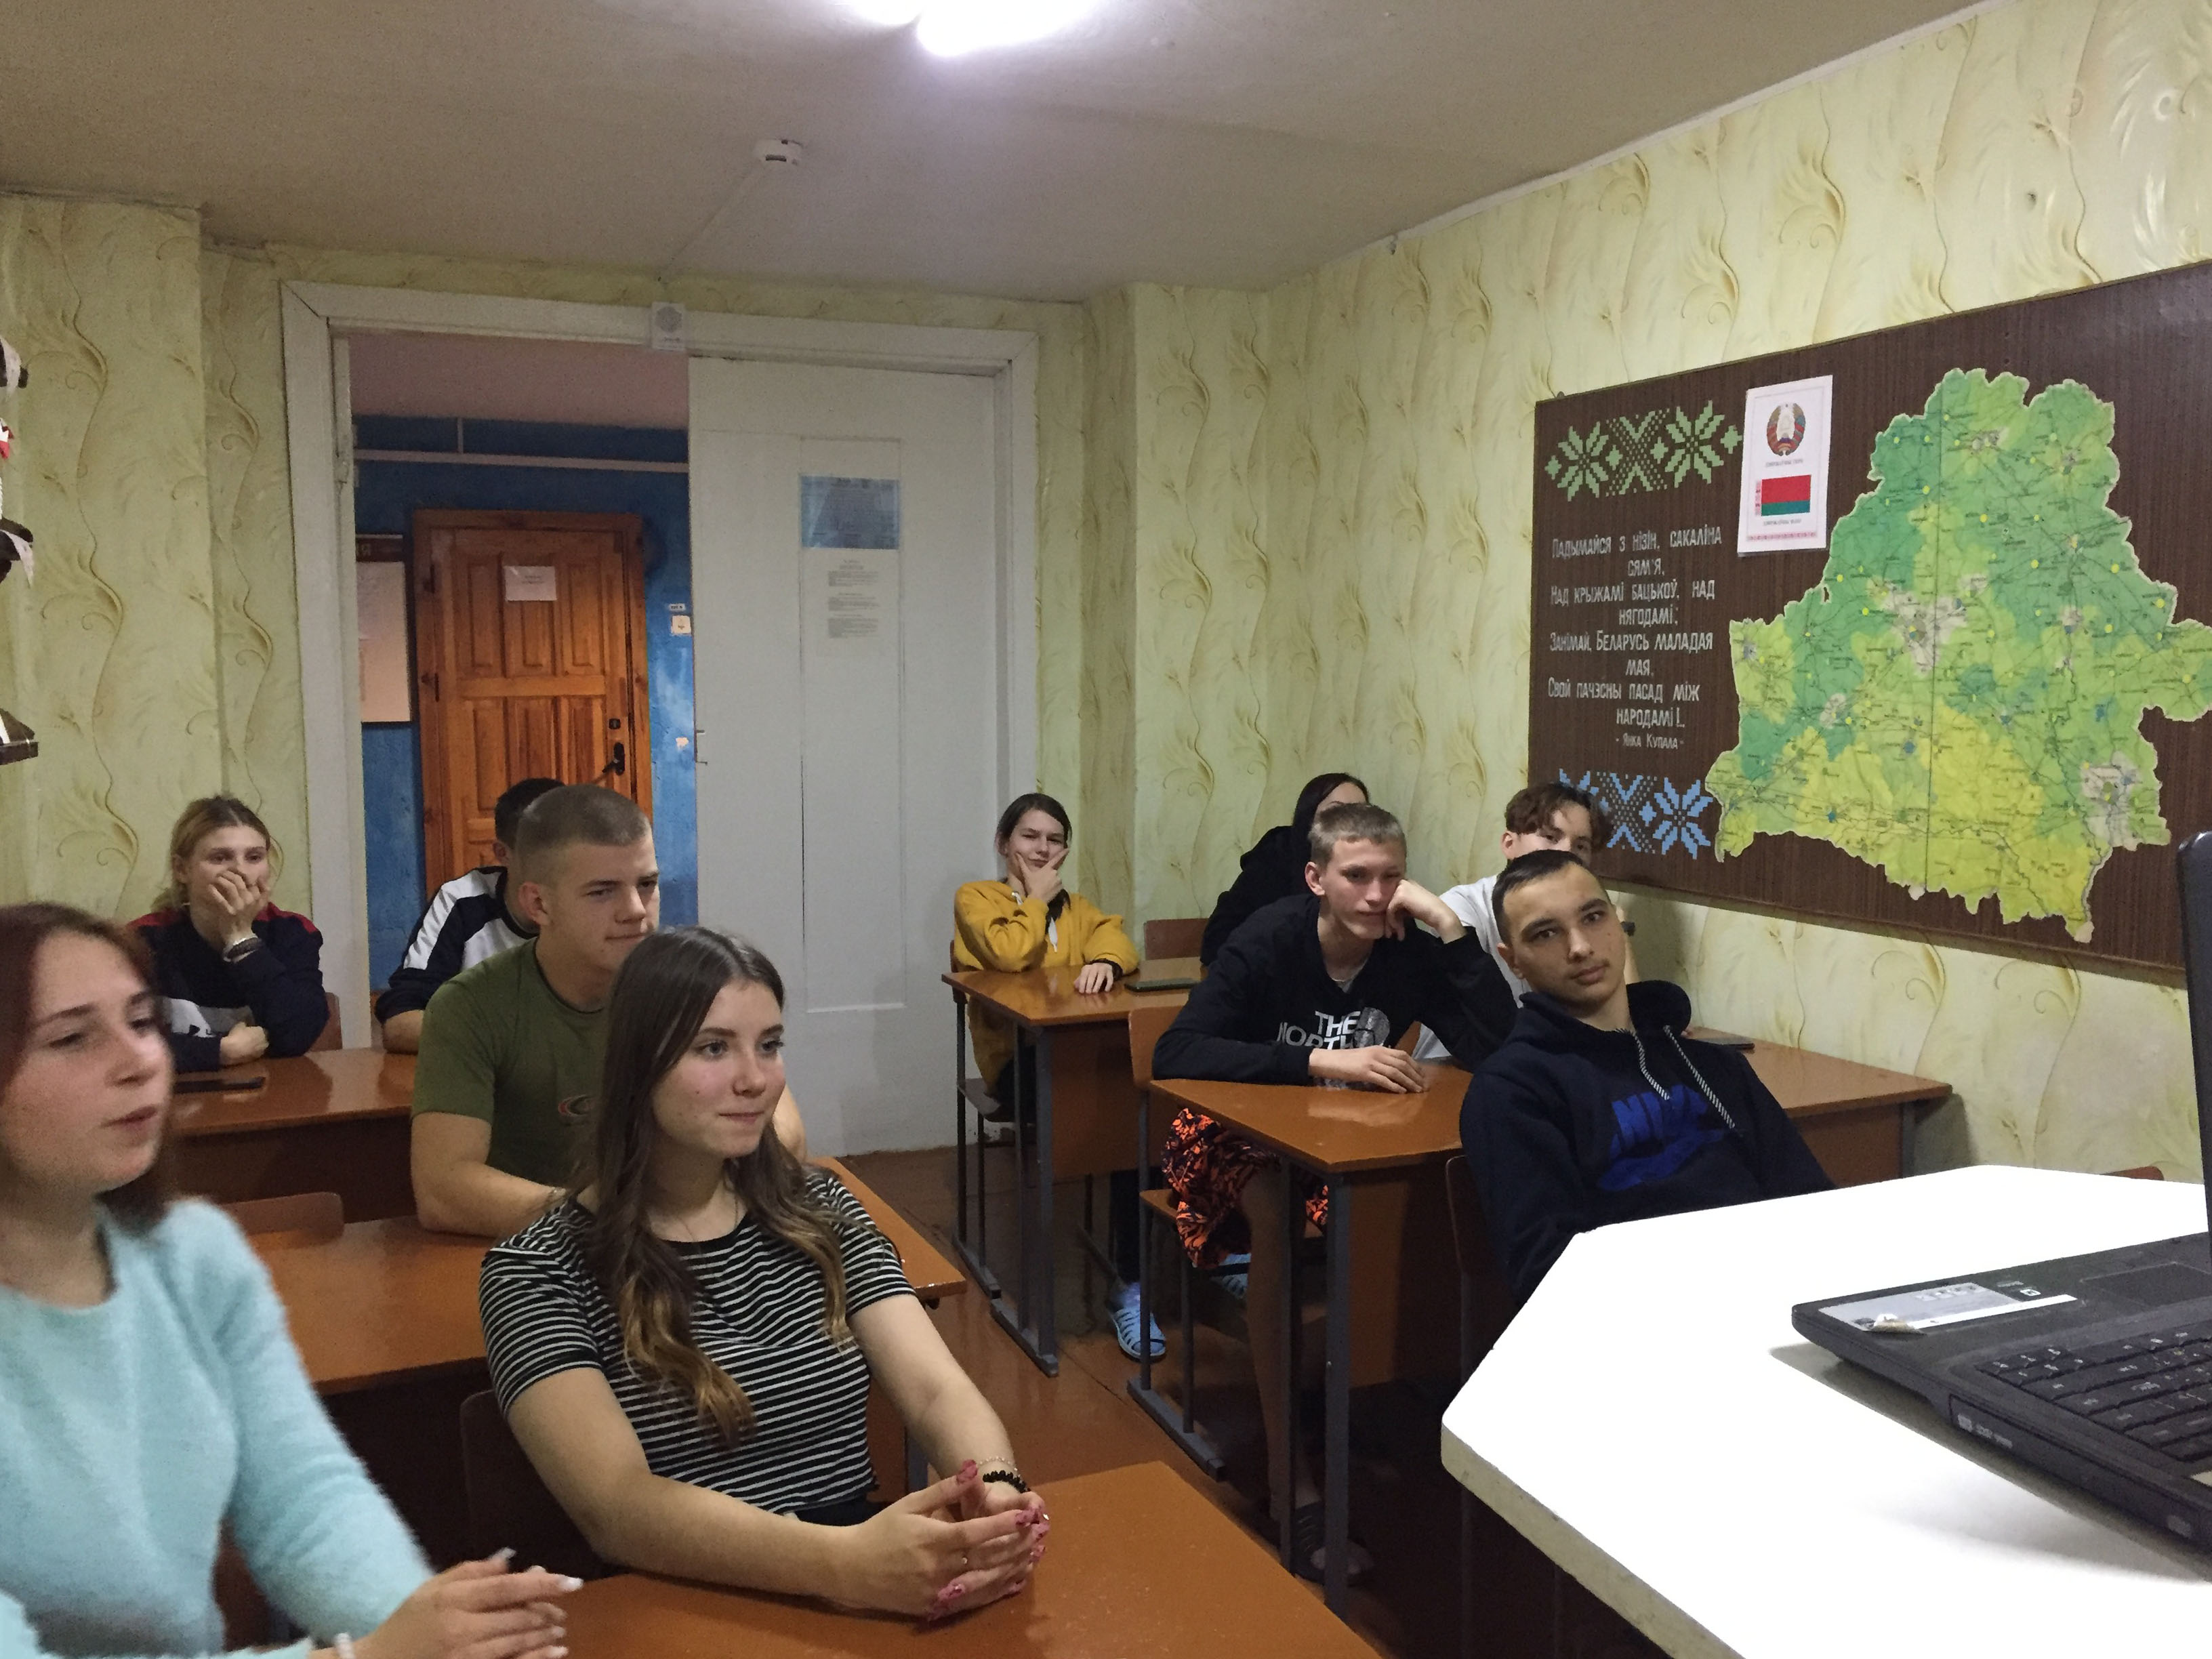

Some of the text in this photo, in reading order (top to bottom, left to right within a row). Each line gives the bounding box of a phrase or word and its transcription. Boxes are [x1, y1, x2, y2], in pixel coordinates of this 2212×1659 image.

[1670, 524, 1722, 548] САКАЛІНА
[1574, 581, 1624, 603] КРЫЖАМІ
[1692, 579, 1715, 600] НАД
[1596, 630, 1650, 651] БЕЛАРУСЬ
[1654, 632, 1713, 653] МАЛАДАЯ
[1576, 682, 1622, 699] ПАЧЭСНЫ
[1629, 683, 1663, 703] ПАСАД
[1673, 680, 1700, 701] МІЖ
[1315, 1010, 1361, 1037] THE
